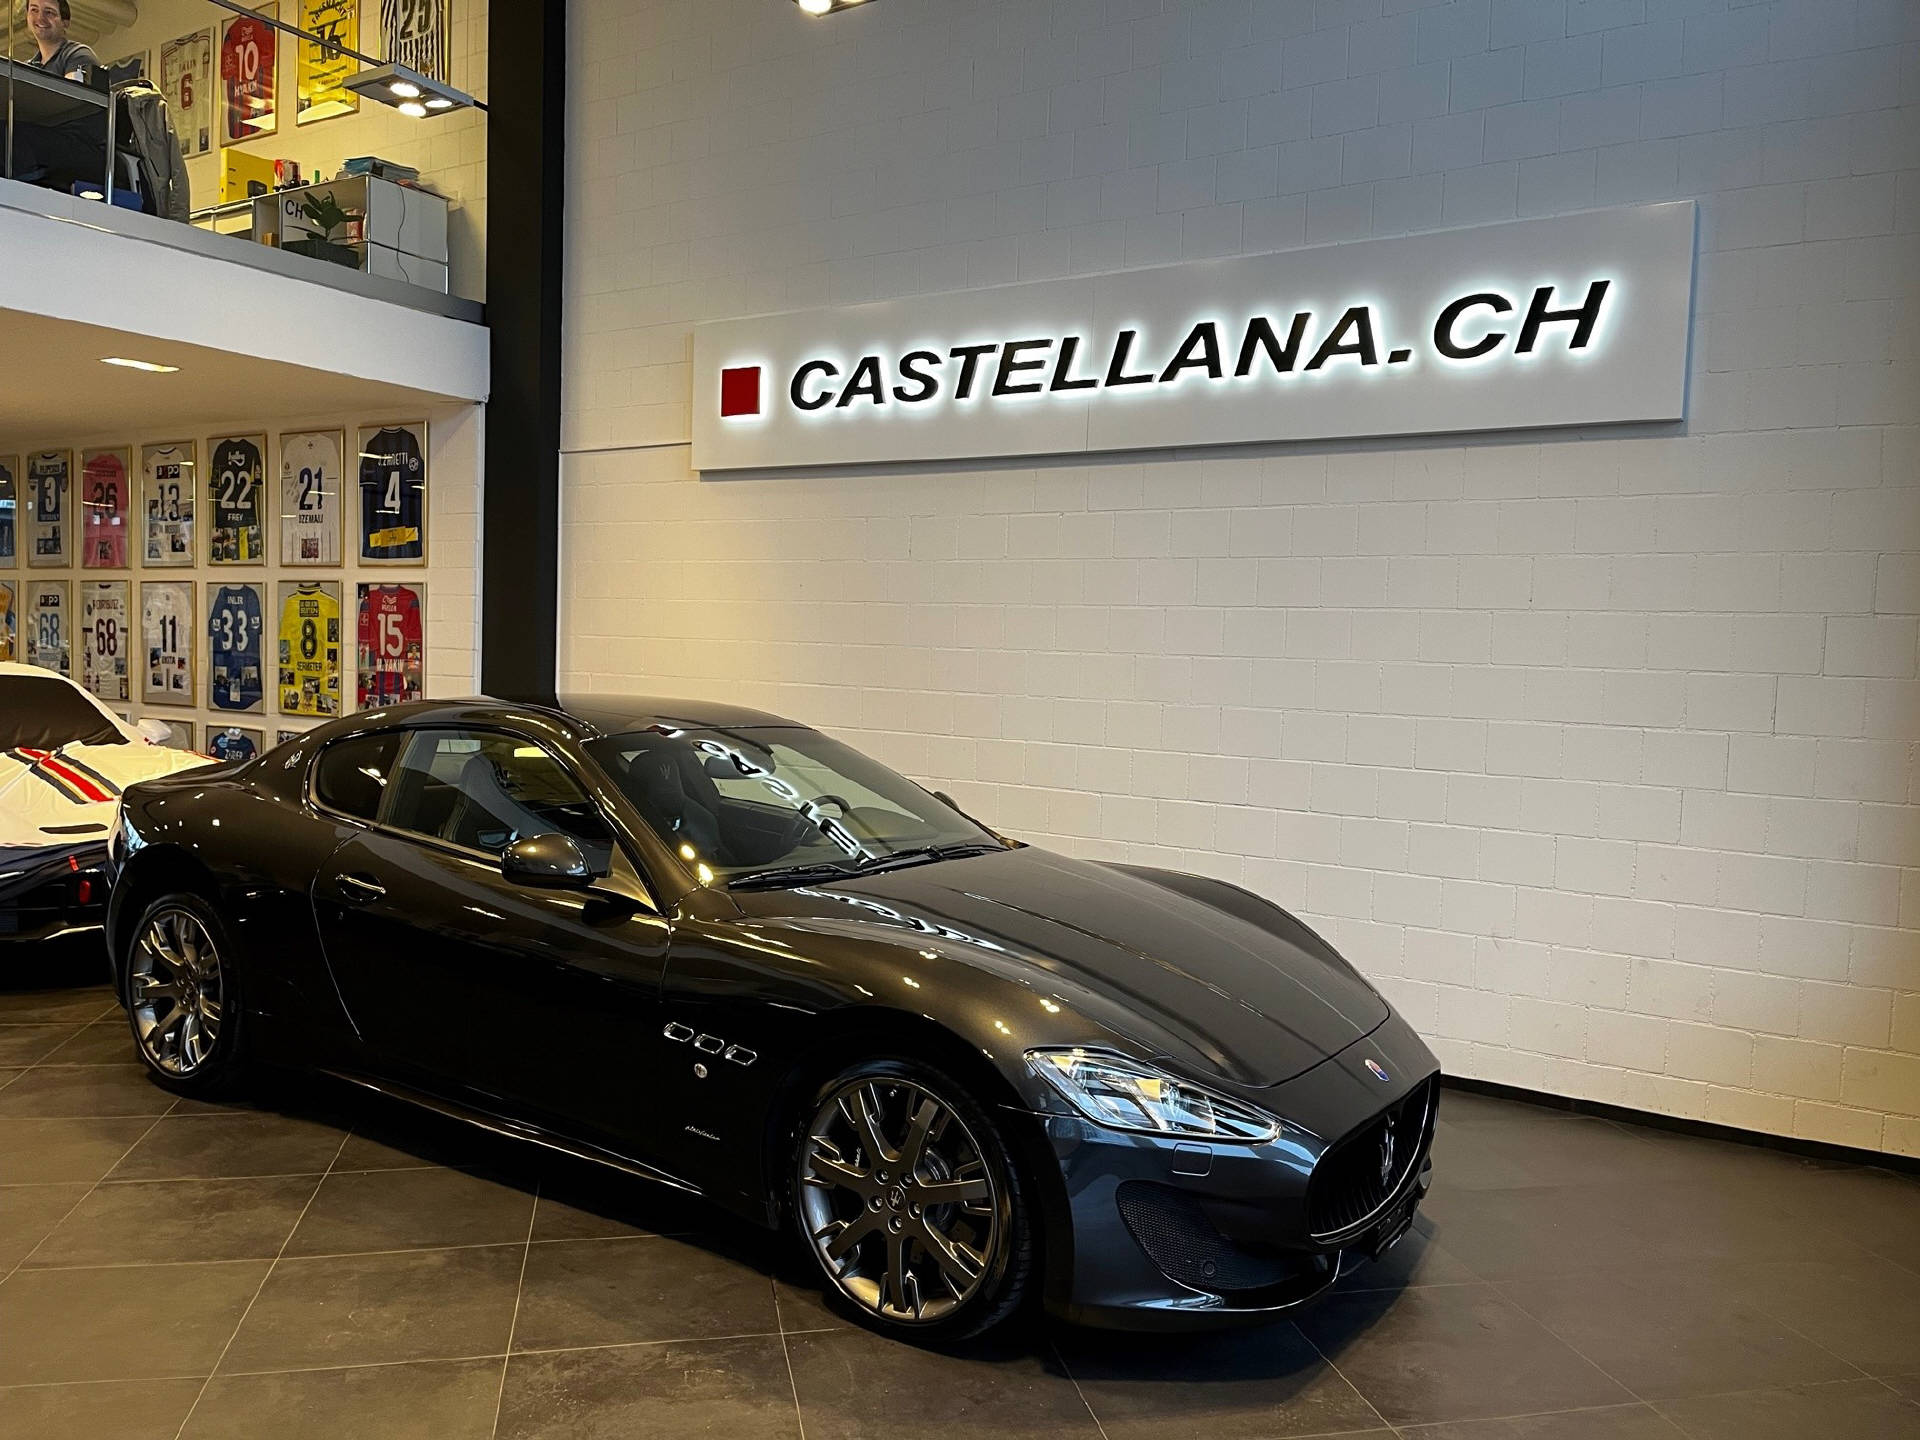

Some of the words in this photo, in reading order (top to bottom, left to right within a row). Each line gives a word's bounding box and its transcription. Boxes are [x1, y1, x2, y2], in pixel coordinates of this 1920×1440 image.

[235, 41, 259, 82] 10
[181, 73, 193, 110] 6
[790, 277, 1610, 410] CASTELLANA.CH
[45, 476, 56, 512] 3
[158, 484, 180, 521] 13
[221, 470, 252, 509] 22
[299, 467, 323, 510] 21
[384, 471, 401, 514] 4
[40, 613, 60, 649] 68
[96, 618, 118, 656] 68
[159, 615, 177, 653] 11
[221, 609, 249, 651] 33
[300, 618, 318, 660] 8
[377, 613, 404, 657] 15
